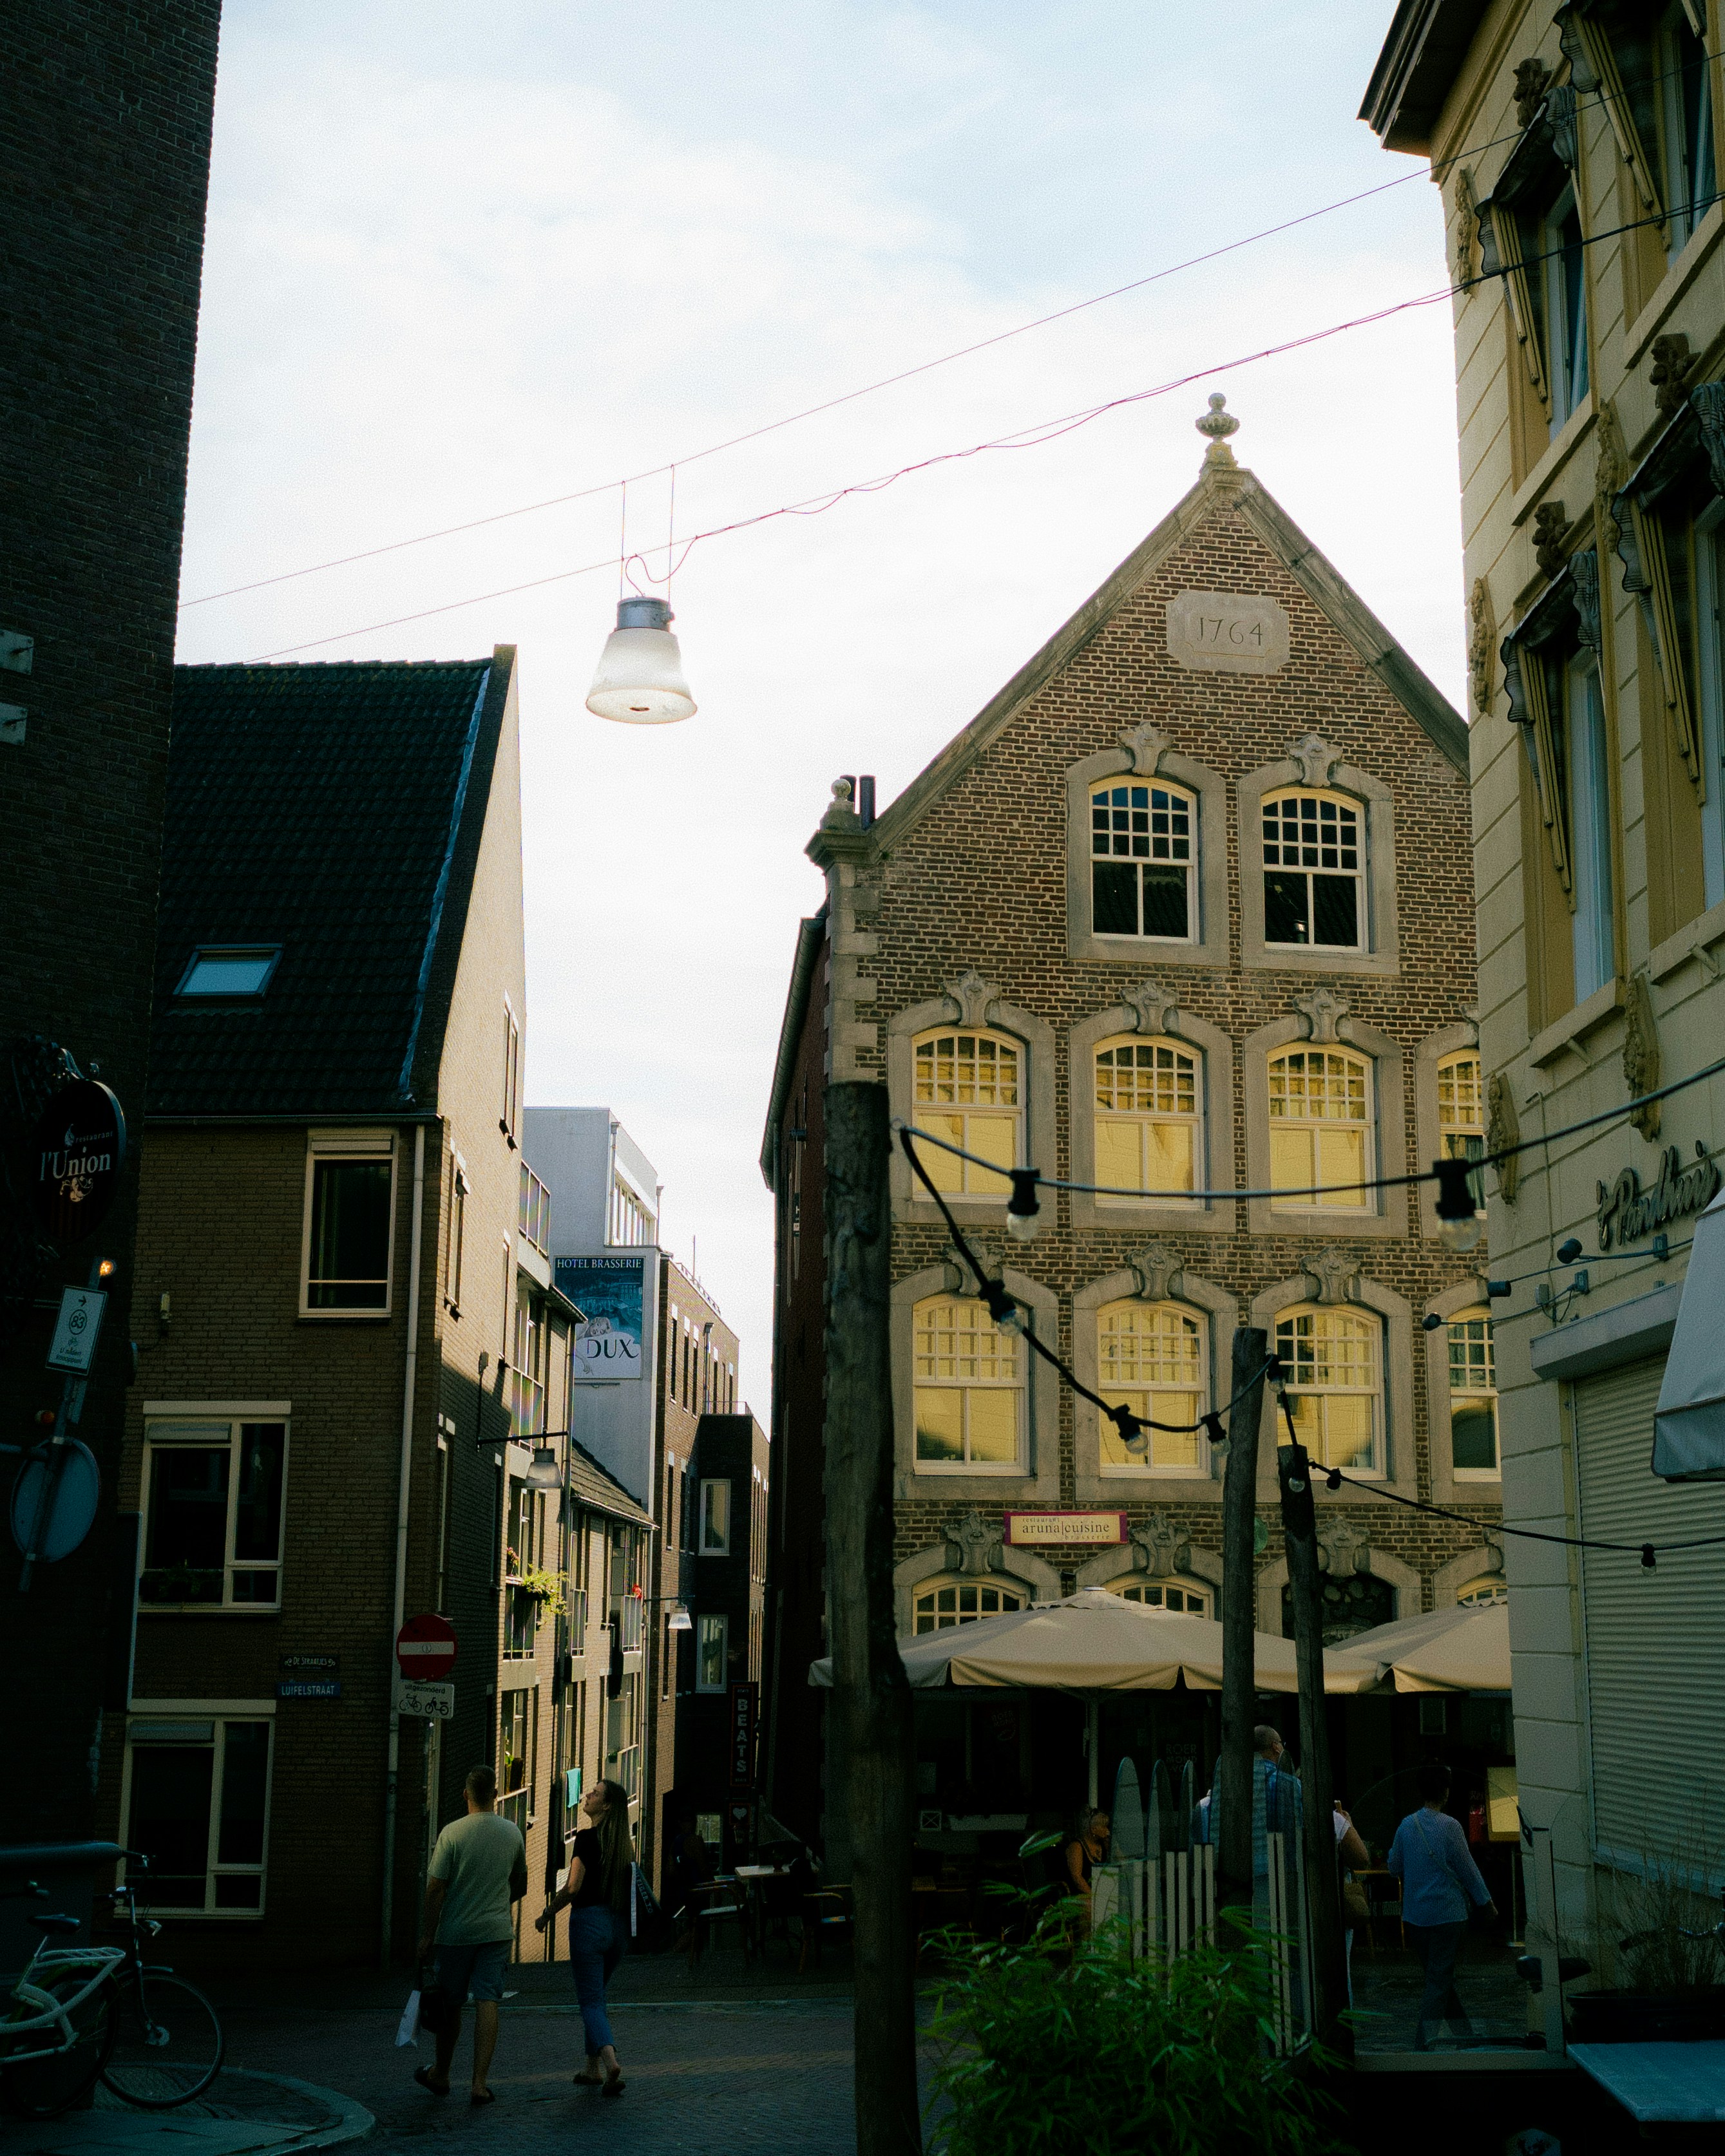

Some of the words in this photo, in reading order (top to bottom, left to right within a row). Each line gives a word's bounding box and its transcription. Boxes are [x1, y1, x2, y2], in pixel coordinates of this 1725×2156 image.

[1196, 616, 1264, 647] 1764
[75, 1130, 113, 1144] restaurant
[39, 1146, 111, 1181] l'Union
[557, 1258, 589, 1269] HOTEL
[591, 1258, 642, 1269] BRASSERIE
[71, 1315, 85, 1329] 83
[587, 1339, 639, 1359] DUX
[281, 1685, 335, 1696] LUIFELSTRAAT
[405, 1684, 446, 1694] uitgezonderd
[736, 1698, 748, 1773] BEATS
[1166, 1743, 1197, 1754] ROER
